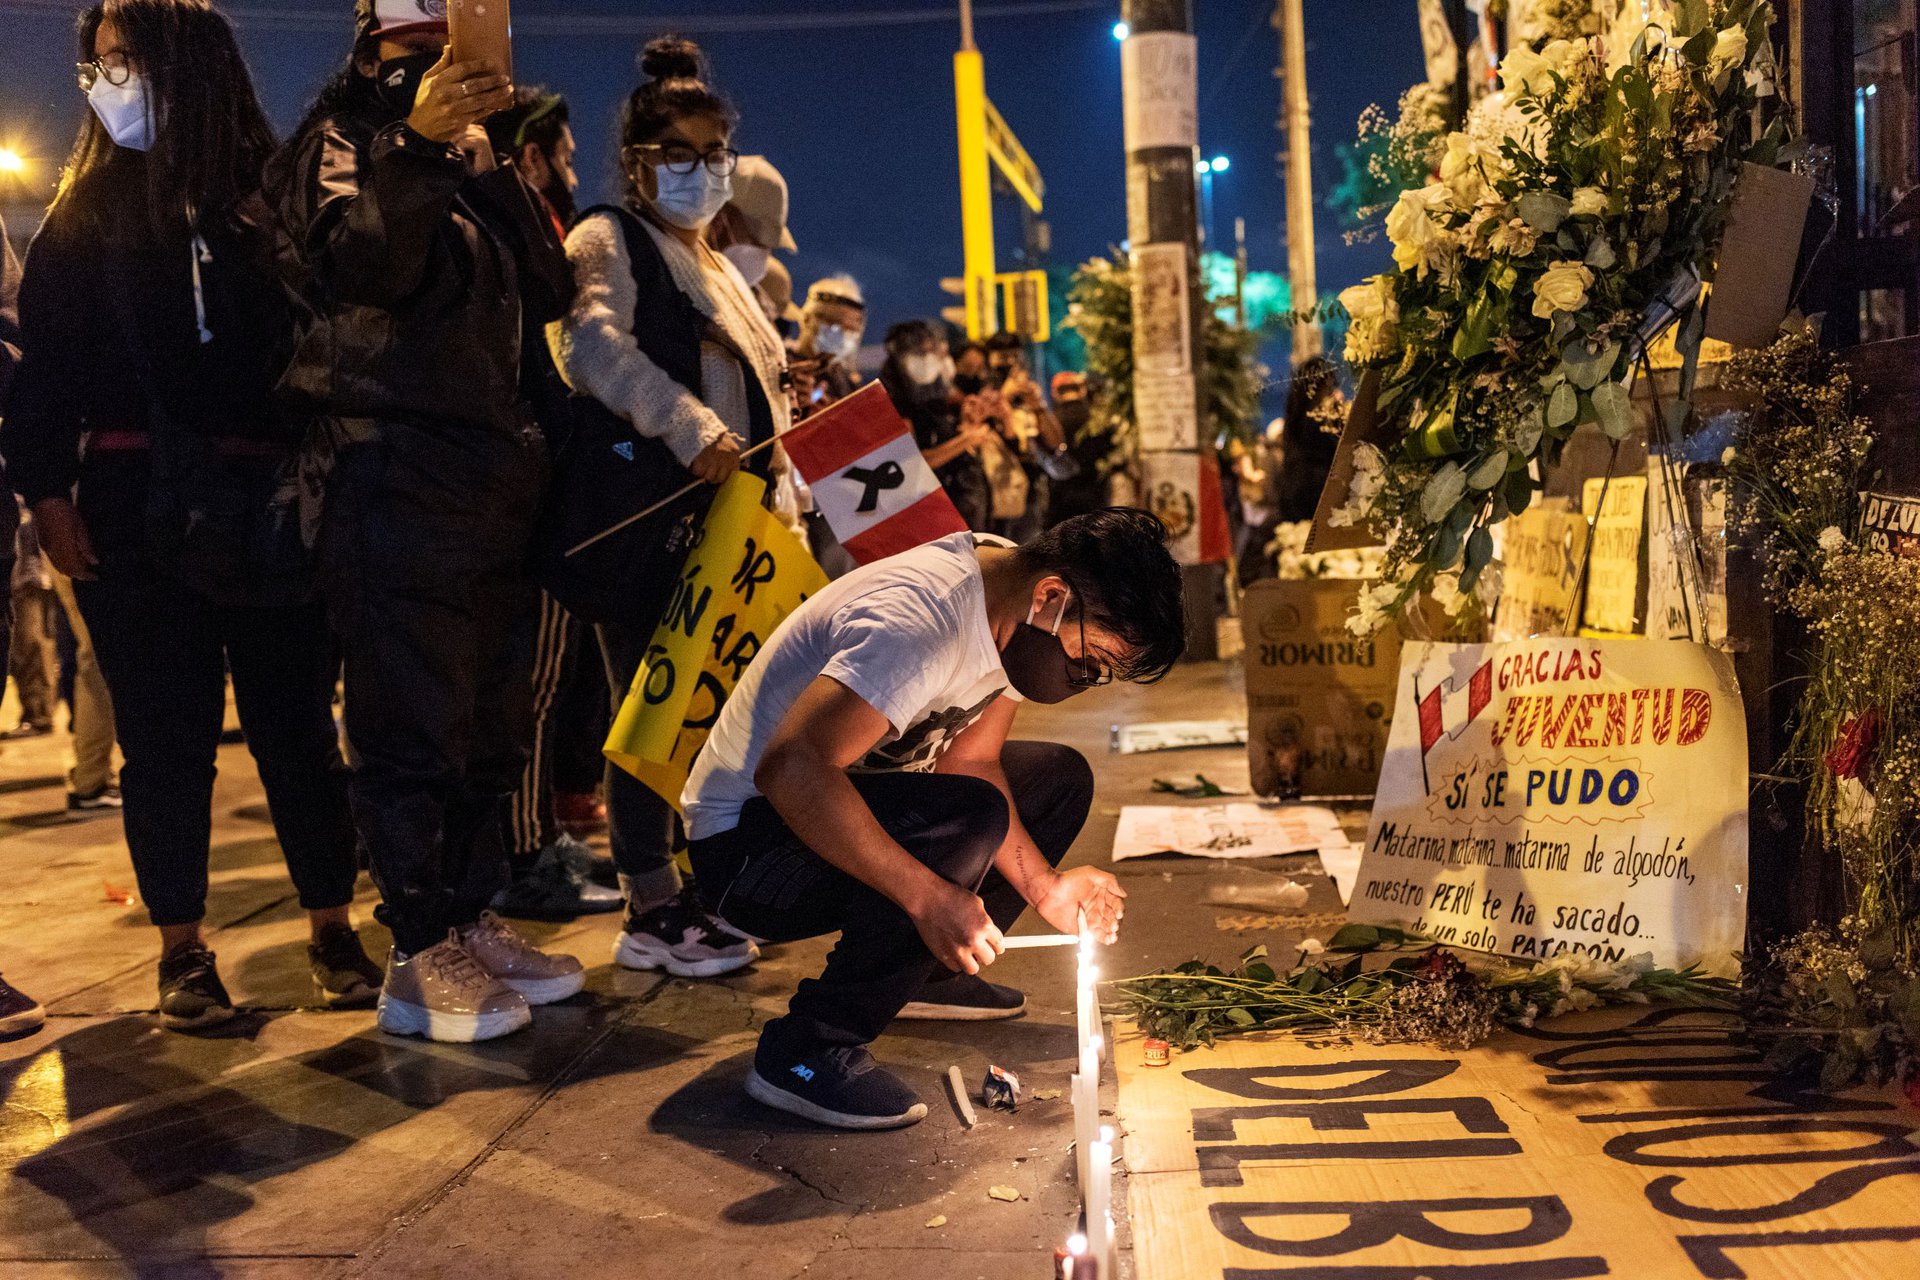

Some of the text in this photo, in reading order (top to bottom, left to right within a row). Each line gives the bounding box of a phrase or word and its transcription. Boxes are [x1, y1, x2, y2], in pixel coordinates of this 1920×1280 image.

[1498, 648, 1602, 692] GRACIAS
[1491, 688, 1712, 748] JUVENTUD
[1482, 771, 1509, 808] SE
[1526, 768, 1640, 808] PUDO
[1503, 830, 1570, 872] matarina
[1584, 834, 1605, 874] de
[1365, 877, 1424, 907] nuestro
[1430, 880, 1475, 916] PERÚ
[1482, 889, 1502, 920] te
[1511, 892, 1536, 926] ha
[1433, 925, 1457, 942] un
[1462, 926, 1497, 950] solo
[1182, 1059, 1524, 1188] DEL
